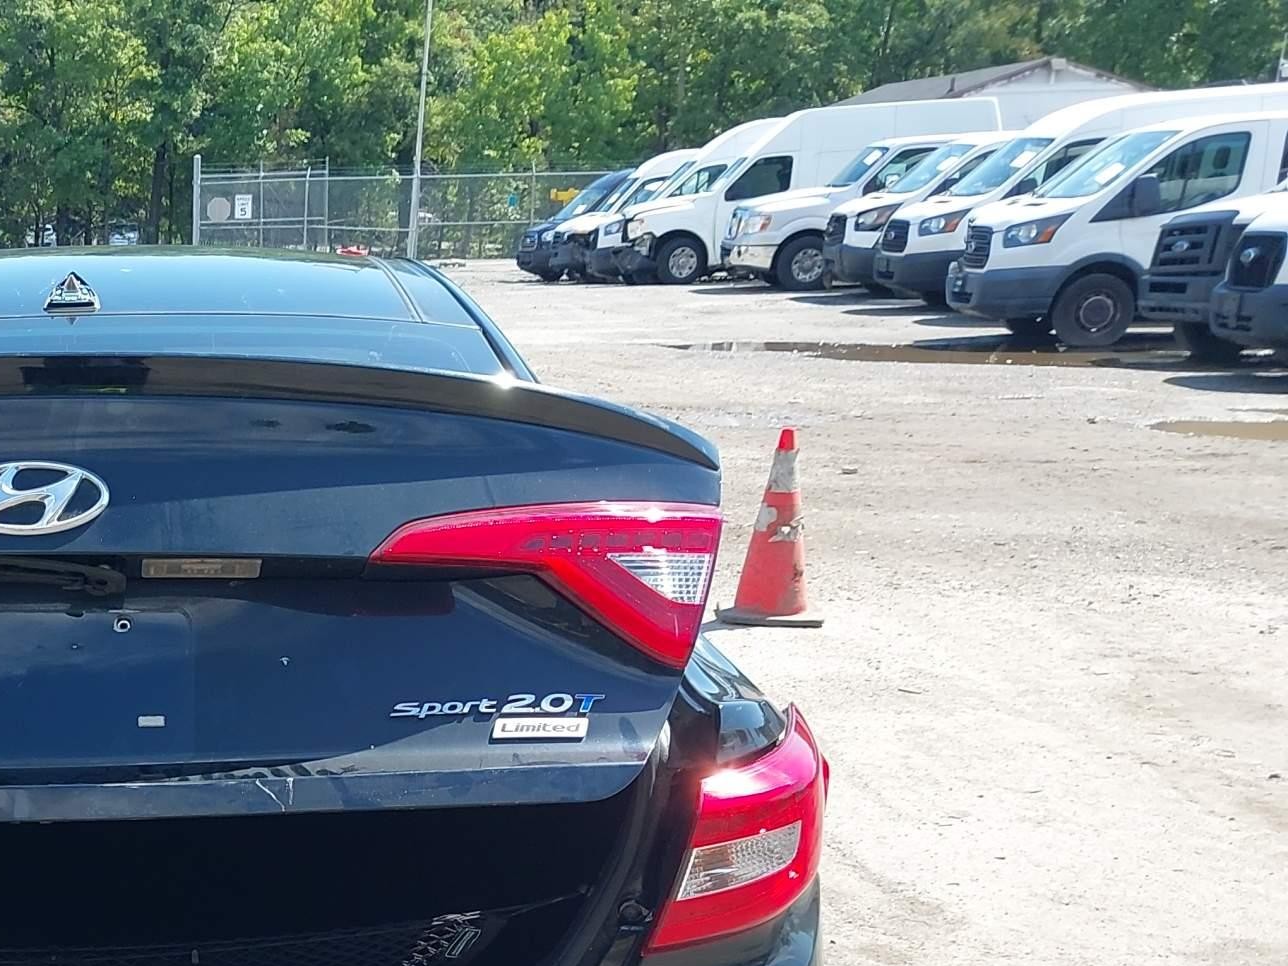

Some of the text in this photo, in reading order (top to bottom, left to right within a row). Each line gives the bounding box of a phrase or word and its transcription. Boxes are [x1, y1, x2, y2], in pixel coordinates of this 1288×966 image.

[240, 207, 247, 216] 5
[501, 693, 606, 713] 2.0T
[501, 721, 580, 733] Limited
